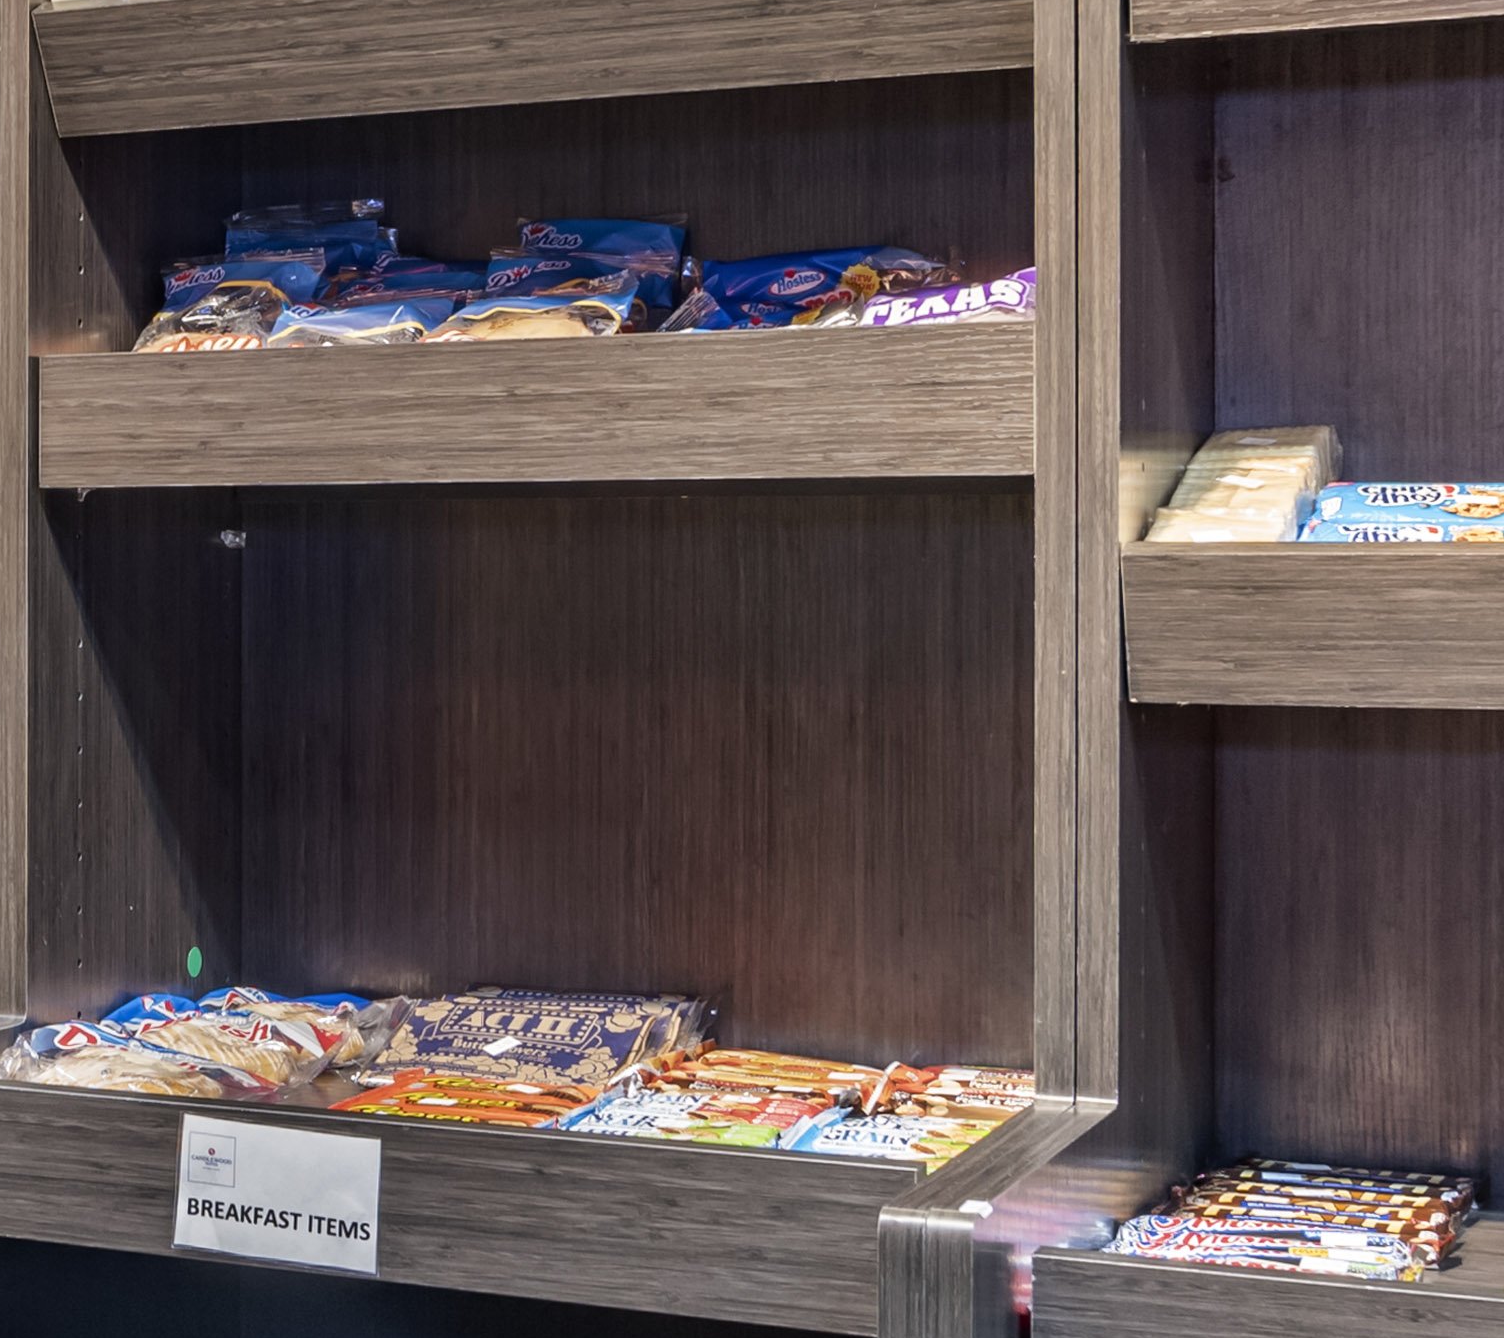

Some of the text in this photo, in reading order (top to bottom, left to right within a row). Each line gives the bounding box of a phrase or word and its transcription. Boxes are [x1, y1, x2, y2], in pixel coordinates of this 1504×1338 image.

[774, 271, 822, 295] Hostess
[461, 1010, 529, 1030] ACT
[187, 1198, 371, 1241] BREAKFAST ITEMS
